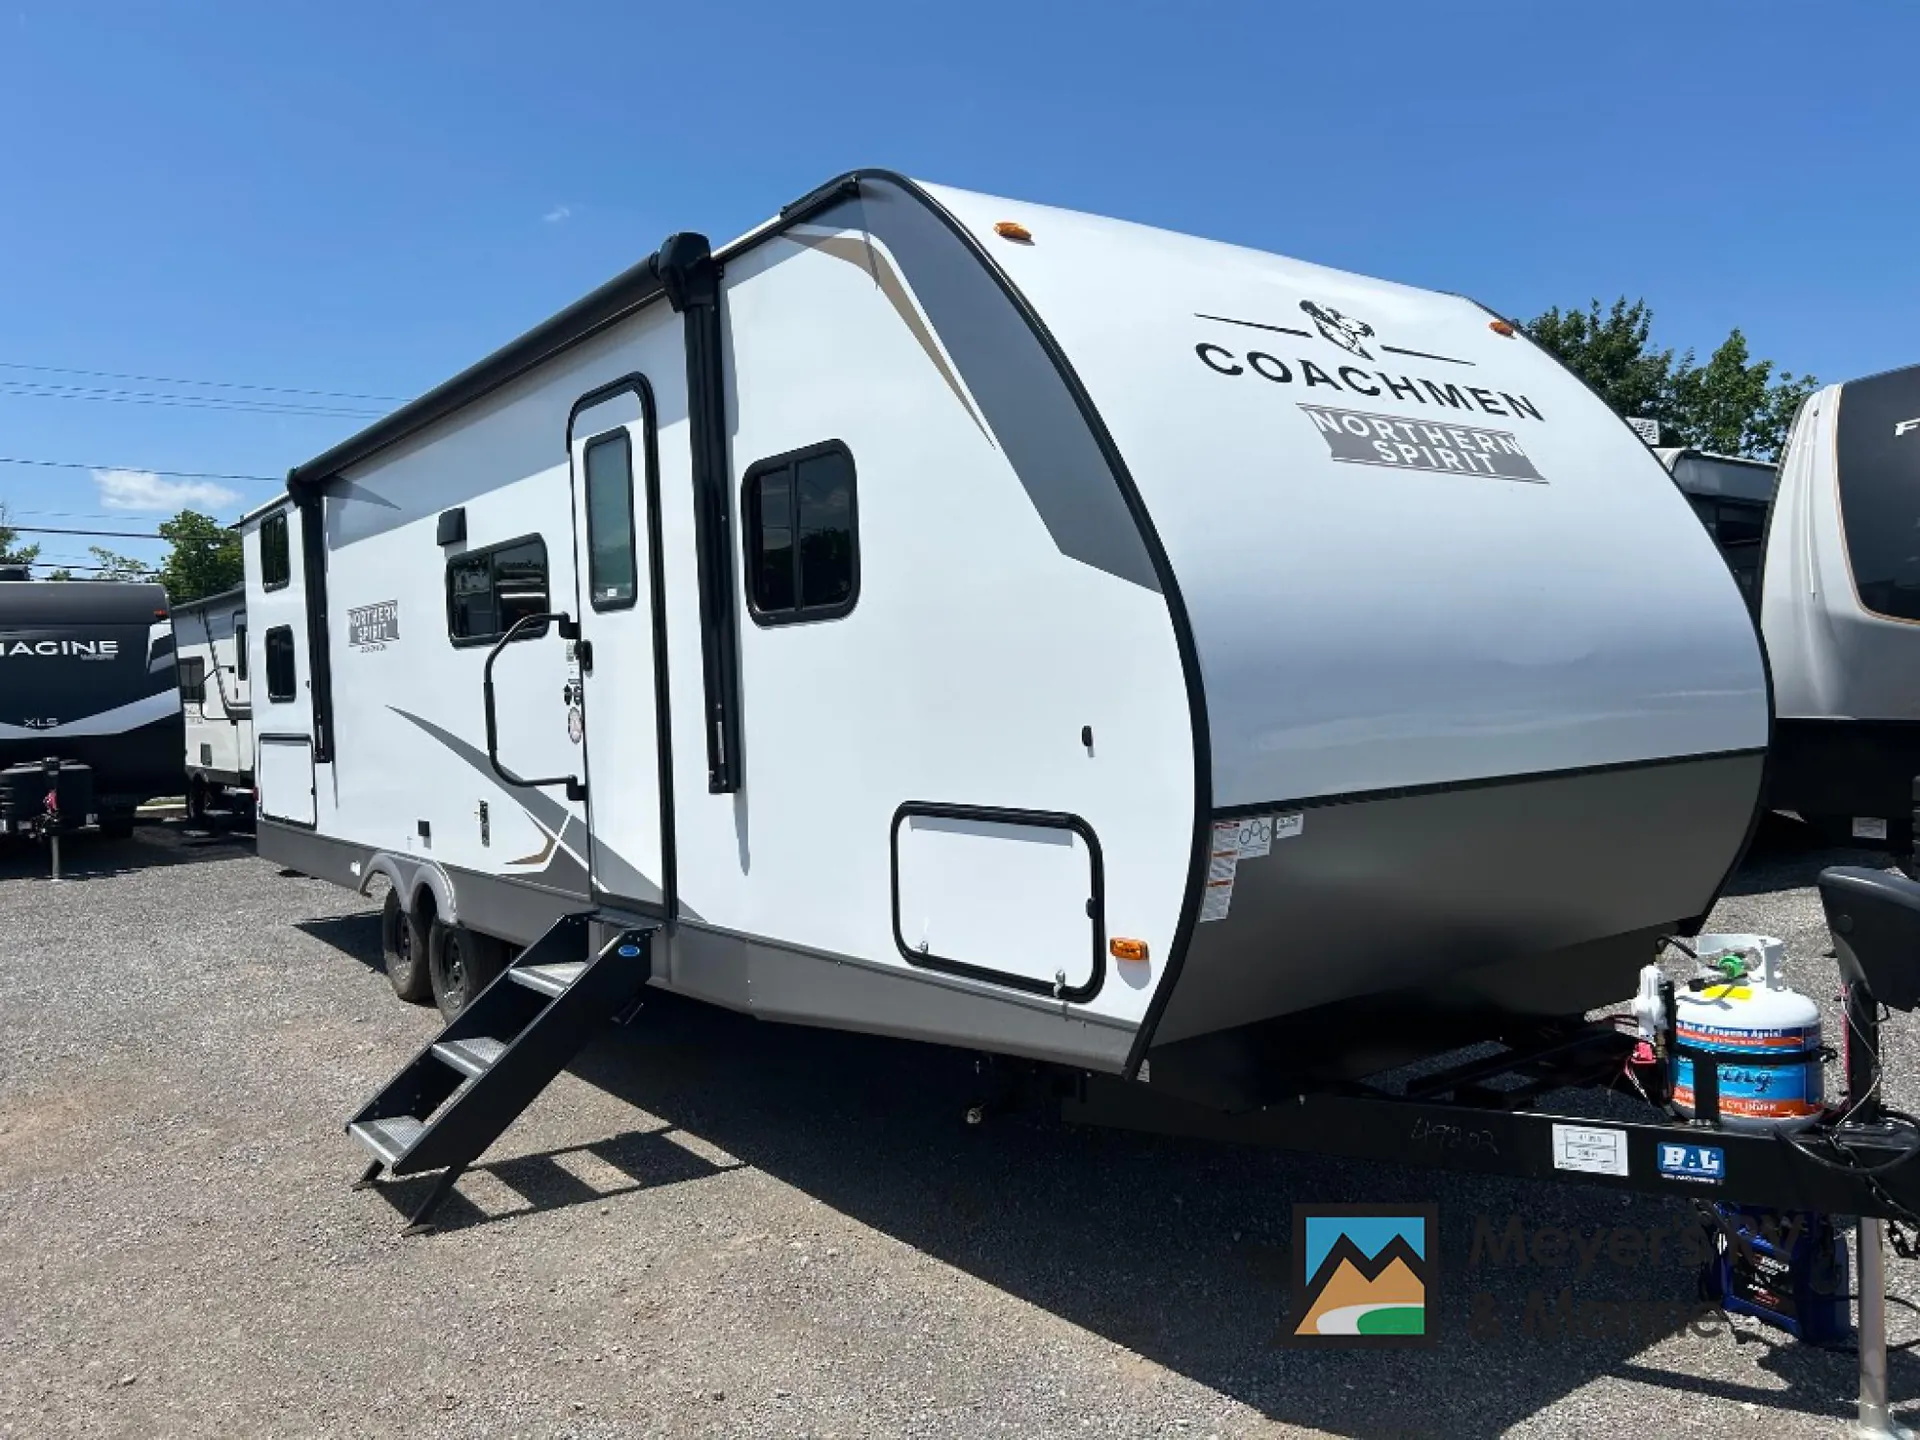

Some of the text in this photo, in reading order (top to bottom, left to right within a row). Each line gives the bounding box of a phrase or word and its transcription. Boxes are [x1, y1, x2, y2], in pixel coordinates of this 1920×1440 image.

[1195, 342, 1546, 422] COACHMEN
[1308, 409, 1528, 458] NORTHERN
[1376, 439, 1498, 474] SPIRIT
[349, 605, 397, 627] NORTHERN
[357, 622, 388, 643] SPIRIT
[24, 717, 59, 728] XLS
